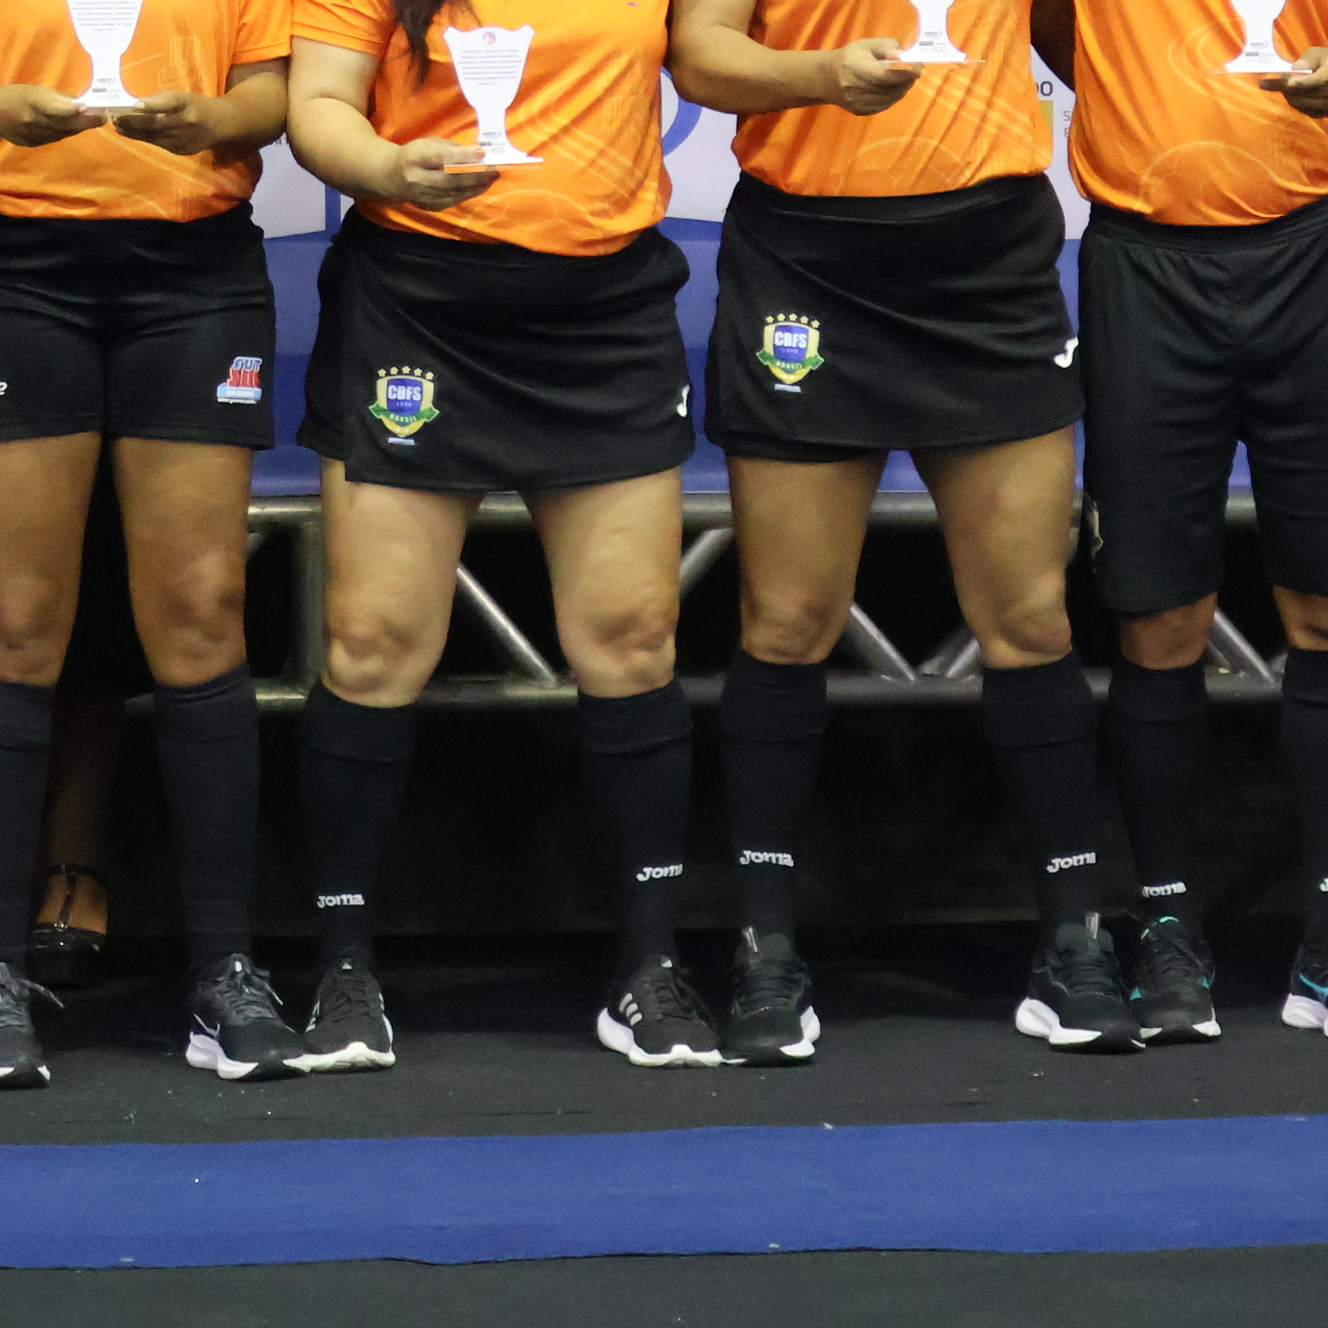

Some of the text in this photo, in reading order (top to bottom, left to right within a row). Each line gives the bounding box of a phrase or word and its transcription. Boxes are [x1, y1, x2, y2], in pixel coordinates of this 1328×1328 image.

[774, 331, 808, 349] CBFS
[388, 385, 422, 401] CBFS
[740, 850, 794, 867] Joma
[316, 893, 364, 908] Joma
